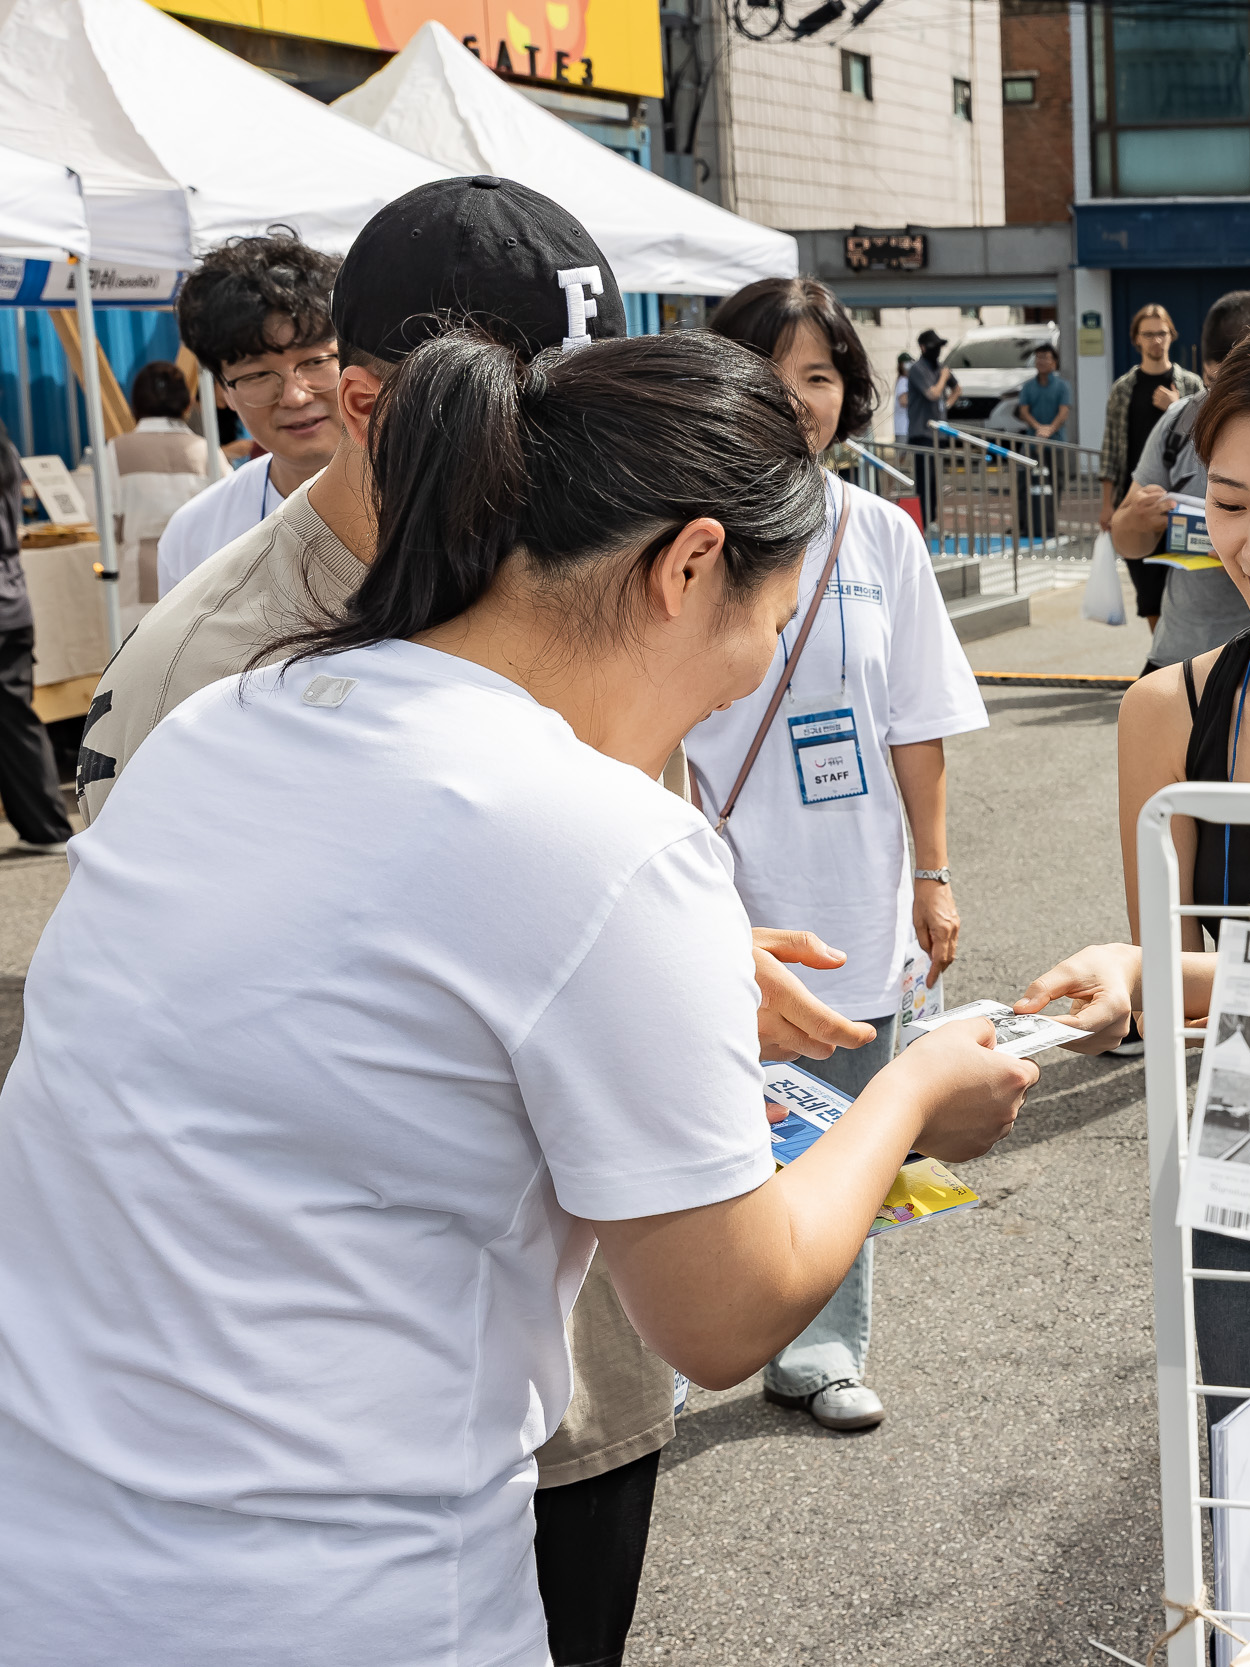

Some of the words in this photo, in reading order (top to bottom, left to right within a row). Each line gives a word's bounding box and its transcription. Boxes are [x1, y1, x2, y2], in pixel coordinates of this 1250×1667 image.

[557, 265, 604, 353] F
[854, 585, 880, 600] 편의점
[815, 771, 849, 784] STAFF
[767, 1079, 830, 1112] 진구네
